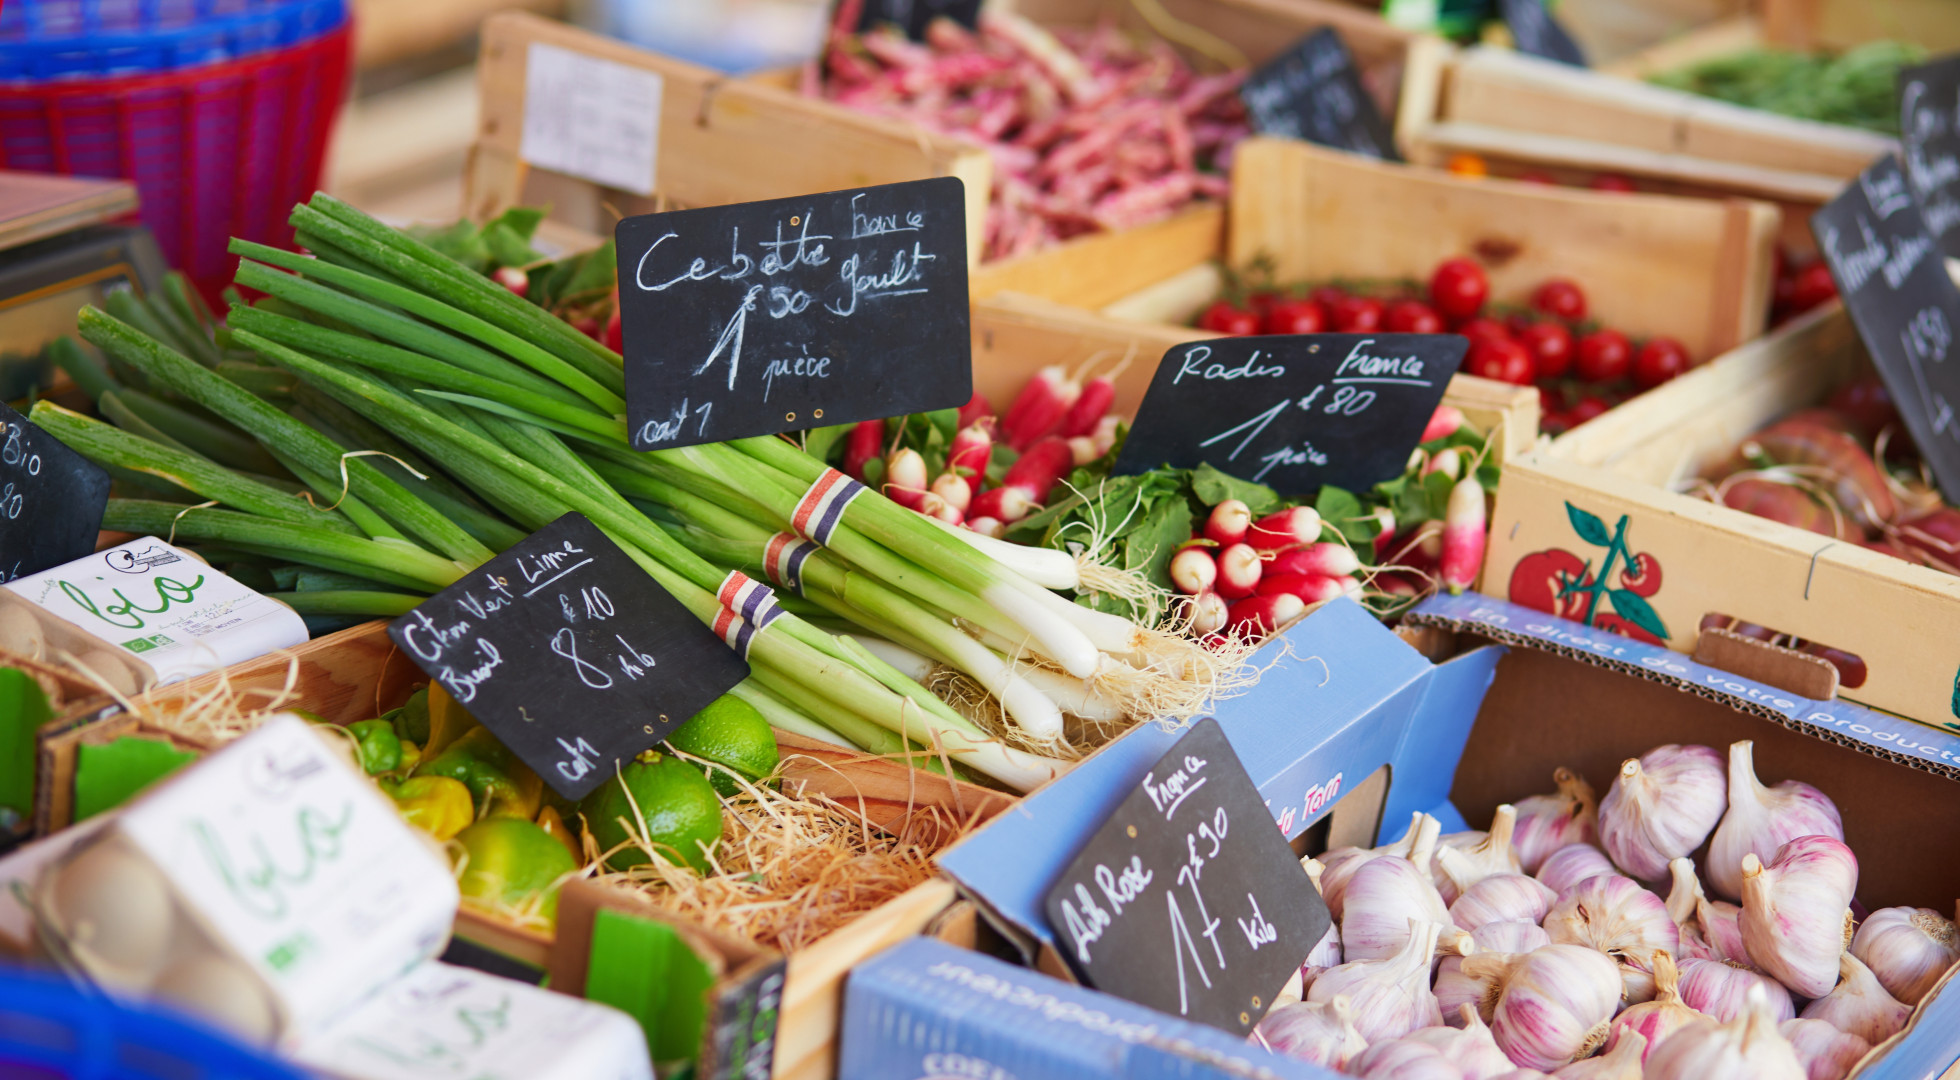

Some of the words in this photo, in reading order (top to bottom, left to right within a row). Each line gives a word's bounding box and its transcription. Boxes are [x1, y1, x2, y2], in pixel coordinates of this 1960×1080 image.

[1173, 346, 1286, 385] Radis
[1336, 340, 1425, 377] France
[3, 423, 41, 476] Bio
[58, 573, 206, 630] bio
[458, 573, 513, 620] Vert
[516, 541, 584, 583] Lime
[1468, 606, 1509, 626] En
[1525, 619, 1627, 657] direct
[1641, 652, 1688, 675] de
[1705, 673, 1795, 710] votre
[1143, 756, 1207, 812] France
[1095, 855, 1154, 915] Rose
[928, 960, 1158, 1043] producteur
